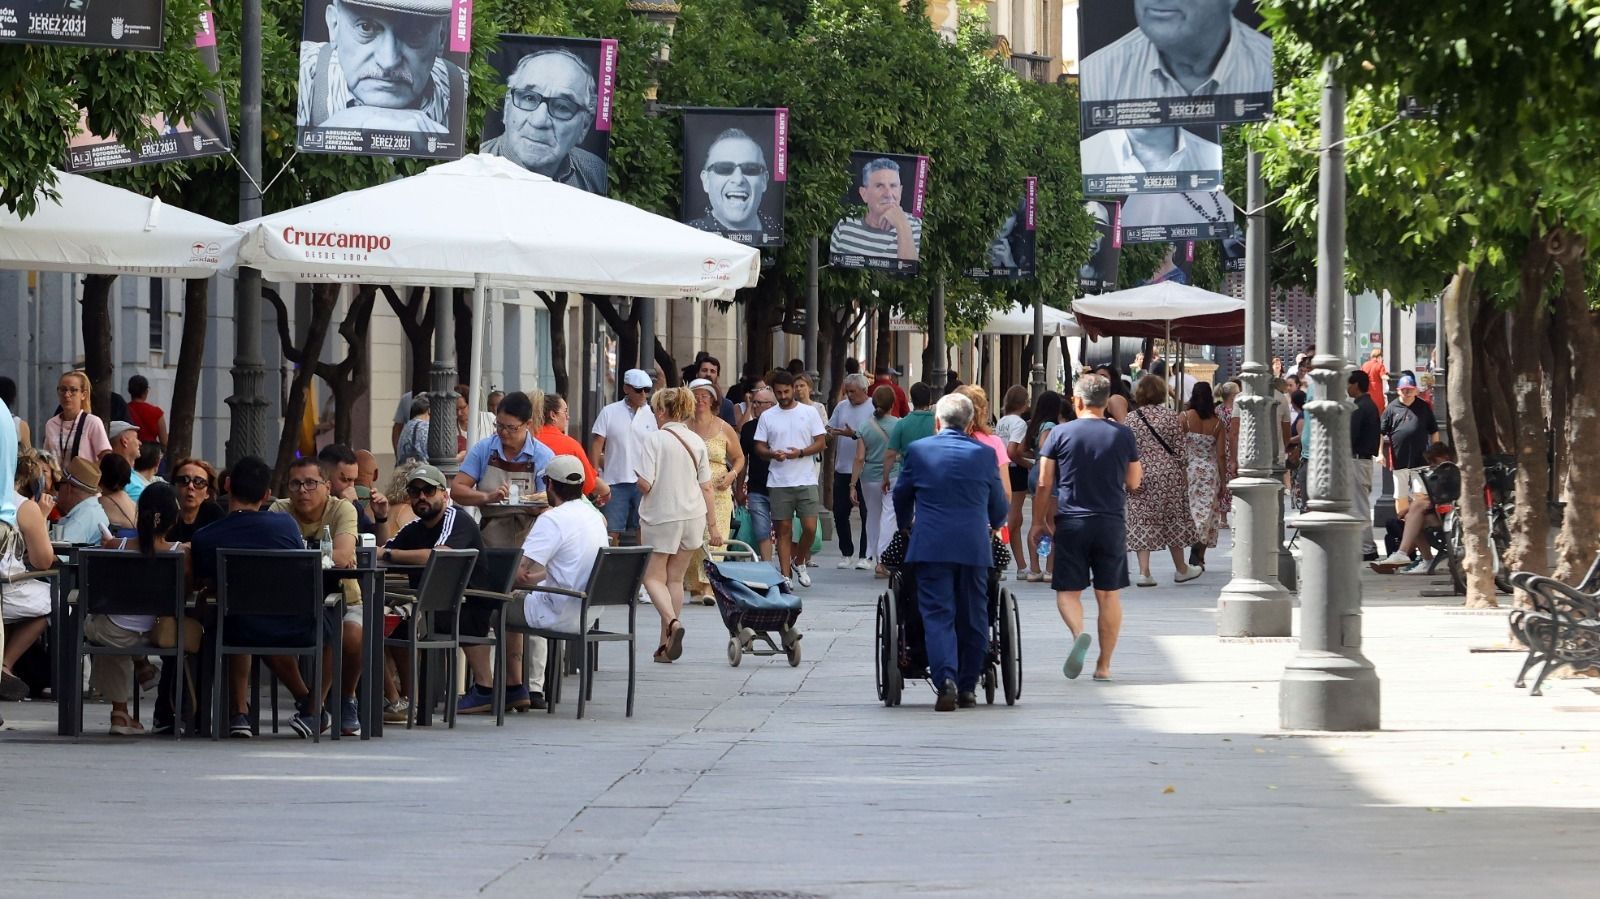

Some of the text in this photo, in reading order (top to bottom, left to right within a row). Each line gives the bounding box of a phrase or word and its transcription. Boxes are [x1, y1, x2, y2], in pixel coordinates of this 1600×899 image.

[28, 16, 87, 33] JEREZ 2031
[457, 7, 467, 42] JEREZ
[605, 75, 611, 86] SU
[1169, 103, 1216, 116] JEREZ 2031
[139, 143, 160, 156] EREZ
[160, 141, 177, 153] 2031
[371, 137, 393, 148] JEREZ
[394, 138, 411, 149] 2031
[283, 226, 391, 252] Cruzcampo
[305, 250, 336, 260] DESDE
